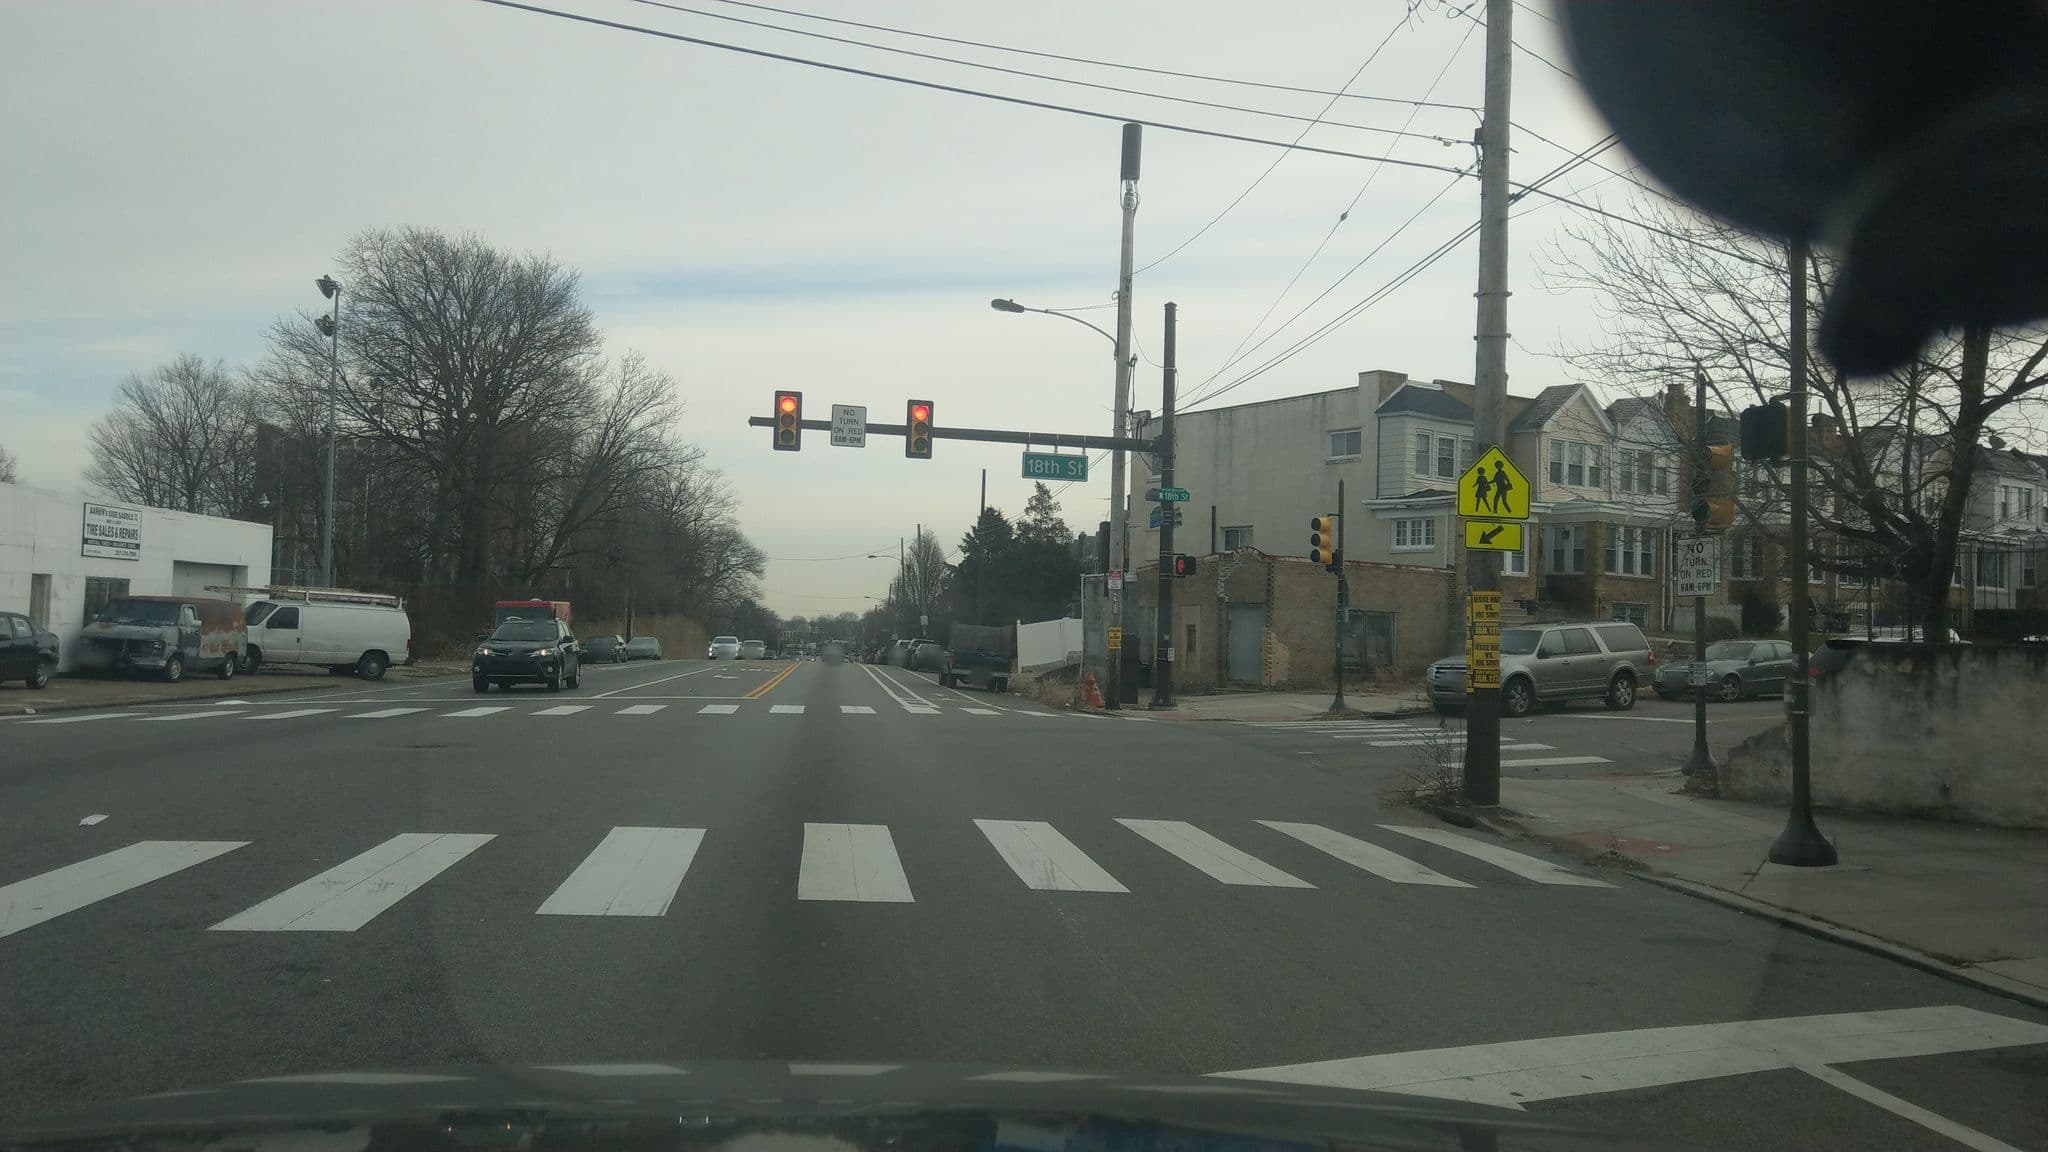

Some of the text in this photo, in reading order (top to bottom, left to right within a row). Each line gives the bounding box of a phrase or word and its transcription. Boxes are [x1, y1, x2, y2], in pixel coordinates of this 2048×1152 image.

[1027, 459, 1084, 476] 18th St
[1165, 492, 1179, 501] 18th
[1182, 493, 1189, 501] St
[87, 523, 138, 540] TIRE SALES & REPAIRS
[1686, 542, 1704, 554] NO
[1684, 557, 1707, 567] TURN
[1680, 568, 1712, 579] ON RED
